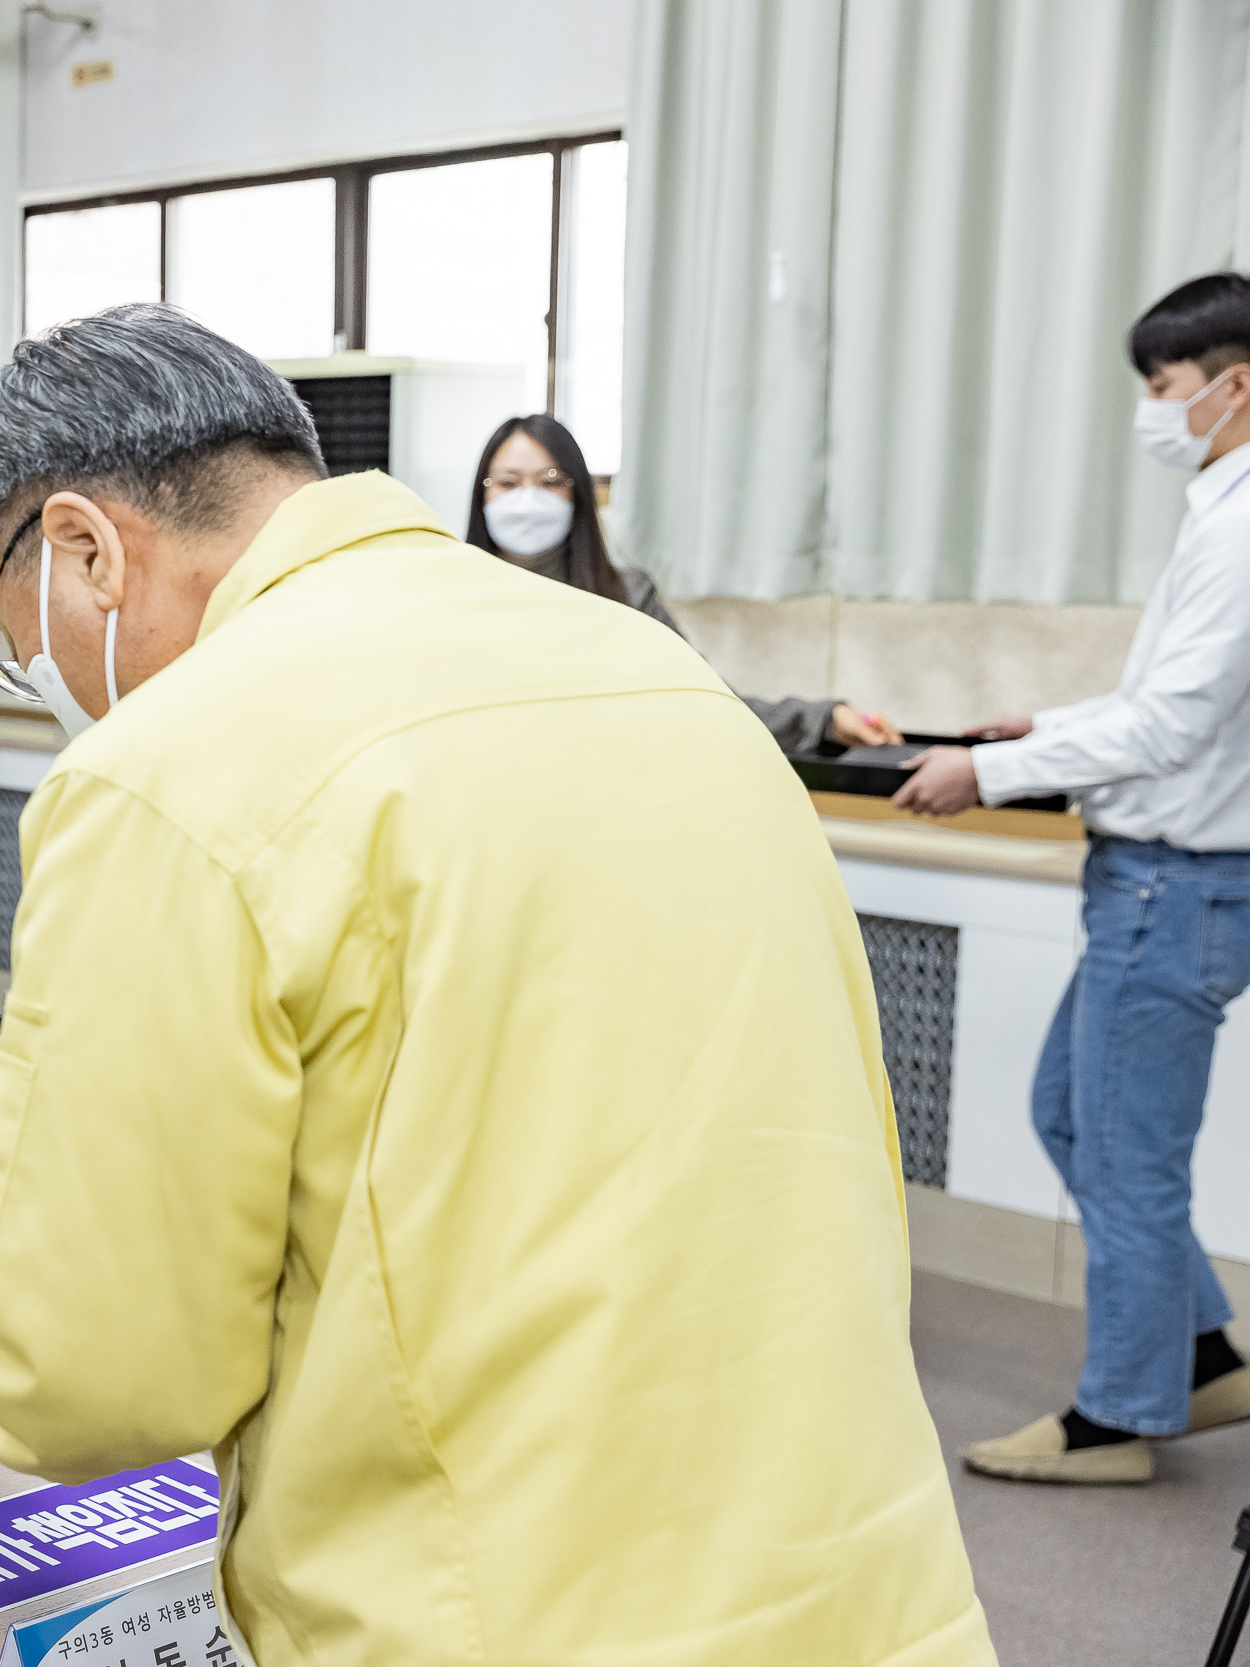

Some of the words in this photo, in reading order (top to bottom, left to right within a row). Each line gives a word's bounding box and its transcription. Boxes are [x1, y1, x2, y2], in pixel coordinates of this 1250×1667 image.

[11, 1475, 220, 1552] 책임진다
[57, 1625, 114, 1660] 구의3동
[121, 1611, 152, 1637] 여성
